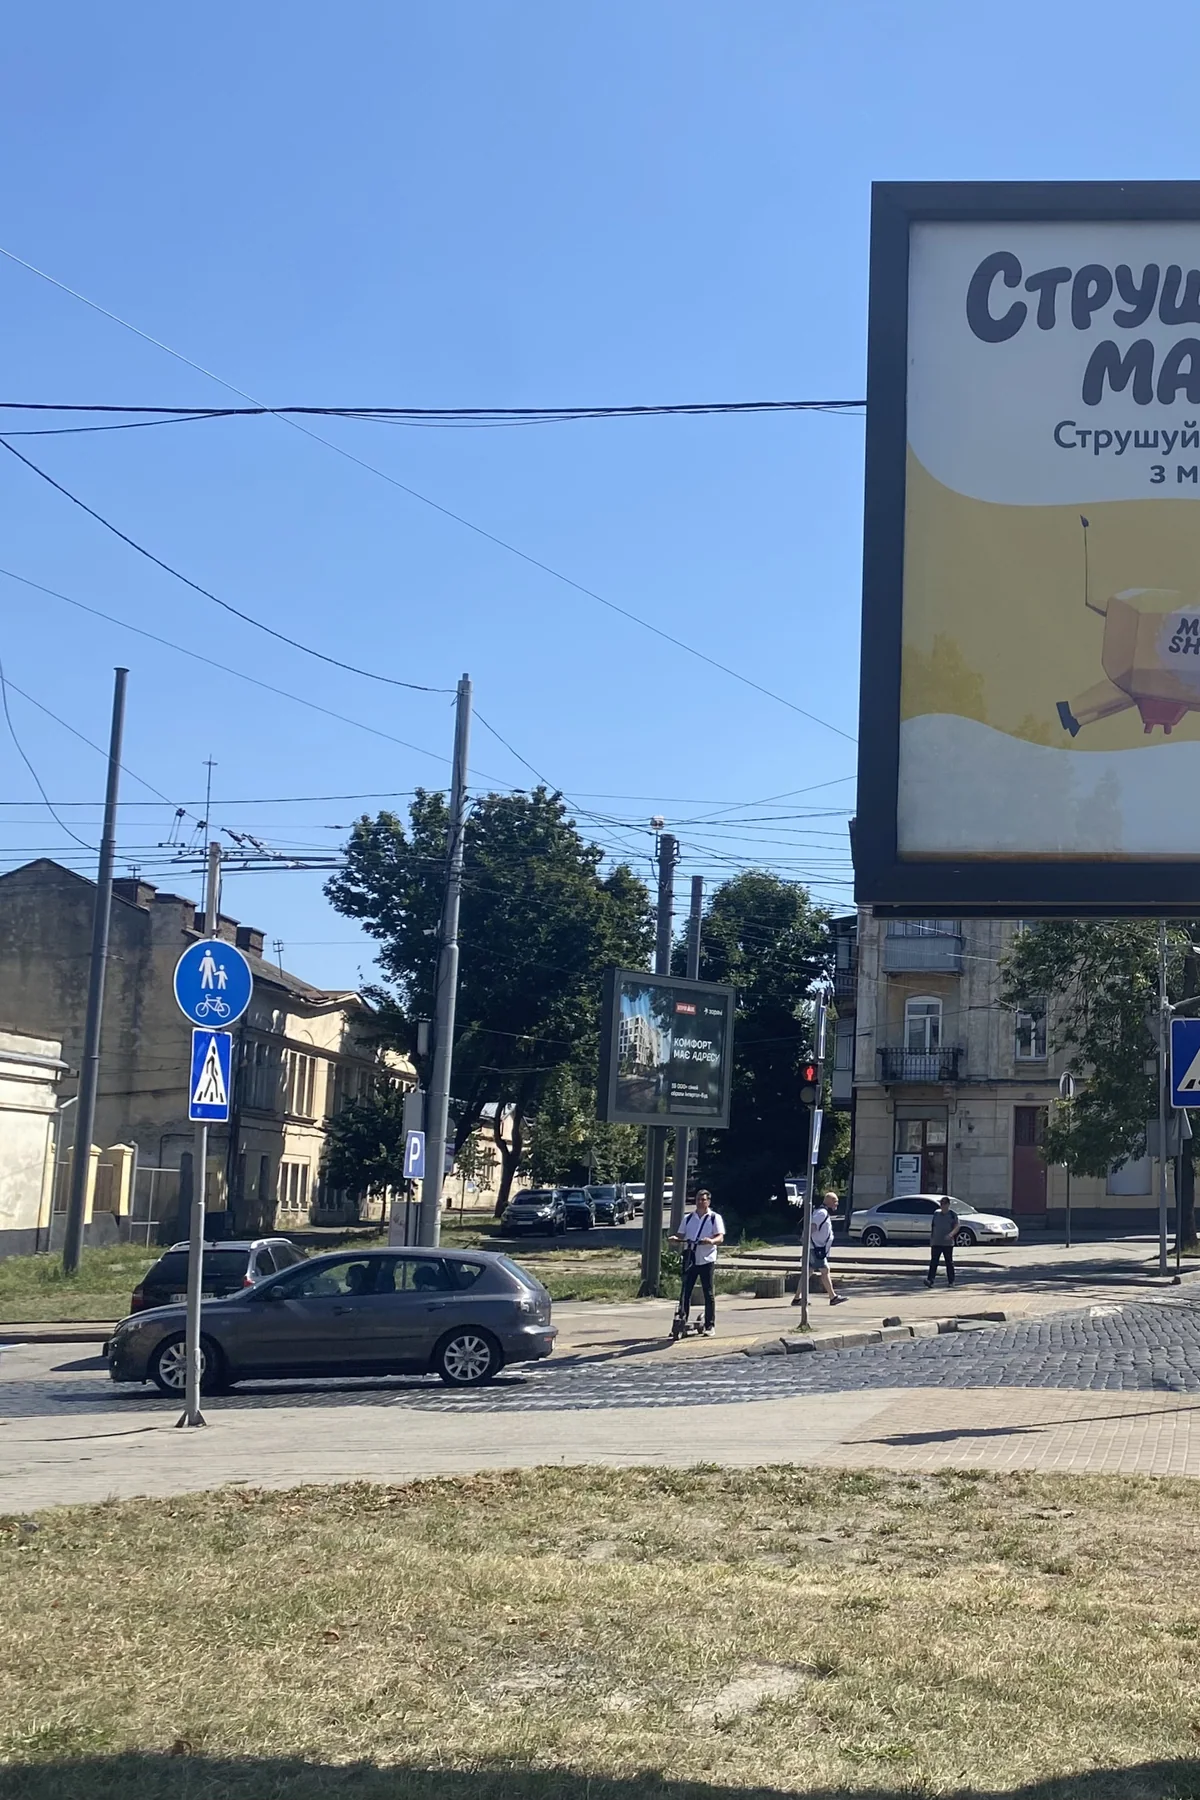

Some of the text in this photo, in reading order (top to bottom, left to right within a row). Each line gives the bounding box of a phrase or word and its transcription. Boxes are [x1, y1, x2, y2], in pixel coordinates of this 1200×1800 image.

[1149, 465, 1166, 484] з
[673, 1037, 712, 1049] КОМФОРТ
[673, 1049, 720, 1062] МАЄ АДРЕСУ
